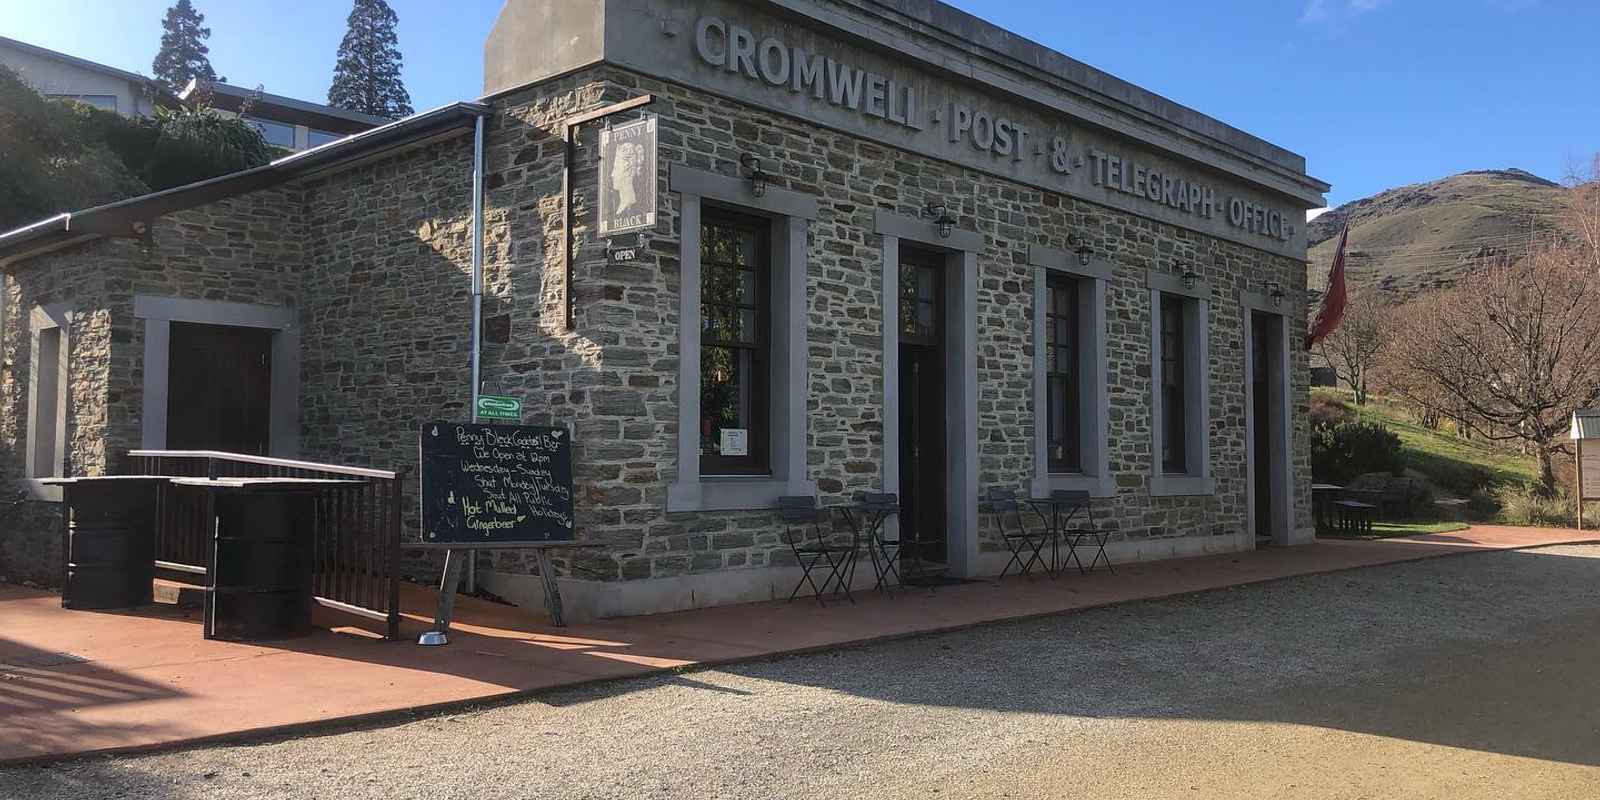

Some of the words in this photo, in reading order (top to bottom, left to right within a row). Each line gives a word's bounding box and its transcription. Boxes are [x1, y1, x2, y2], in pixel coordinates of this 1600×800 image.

[614, 126, 642, 141] PENNY
[696, 16, 923, 131] CROMWELL
[950, 102, 1026, 161] POST
[1052, 136, 1072, 174] &
[1088, 151, 1214, 218] TELEGRAPH
[1227, 196, 1289, 241] OFFICE
[614, 214, 641, 229] BLACK
[614, 249, 635, 261] OPEN
[456, 426, 484, 447] Penny
[474, 446, 489, 459] We
[493, 448, 514, 462] Open
[515, 451, 526, 461] at
[462, 496, 482, 516] Hot
